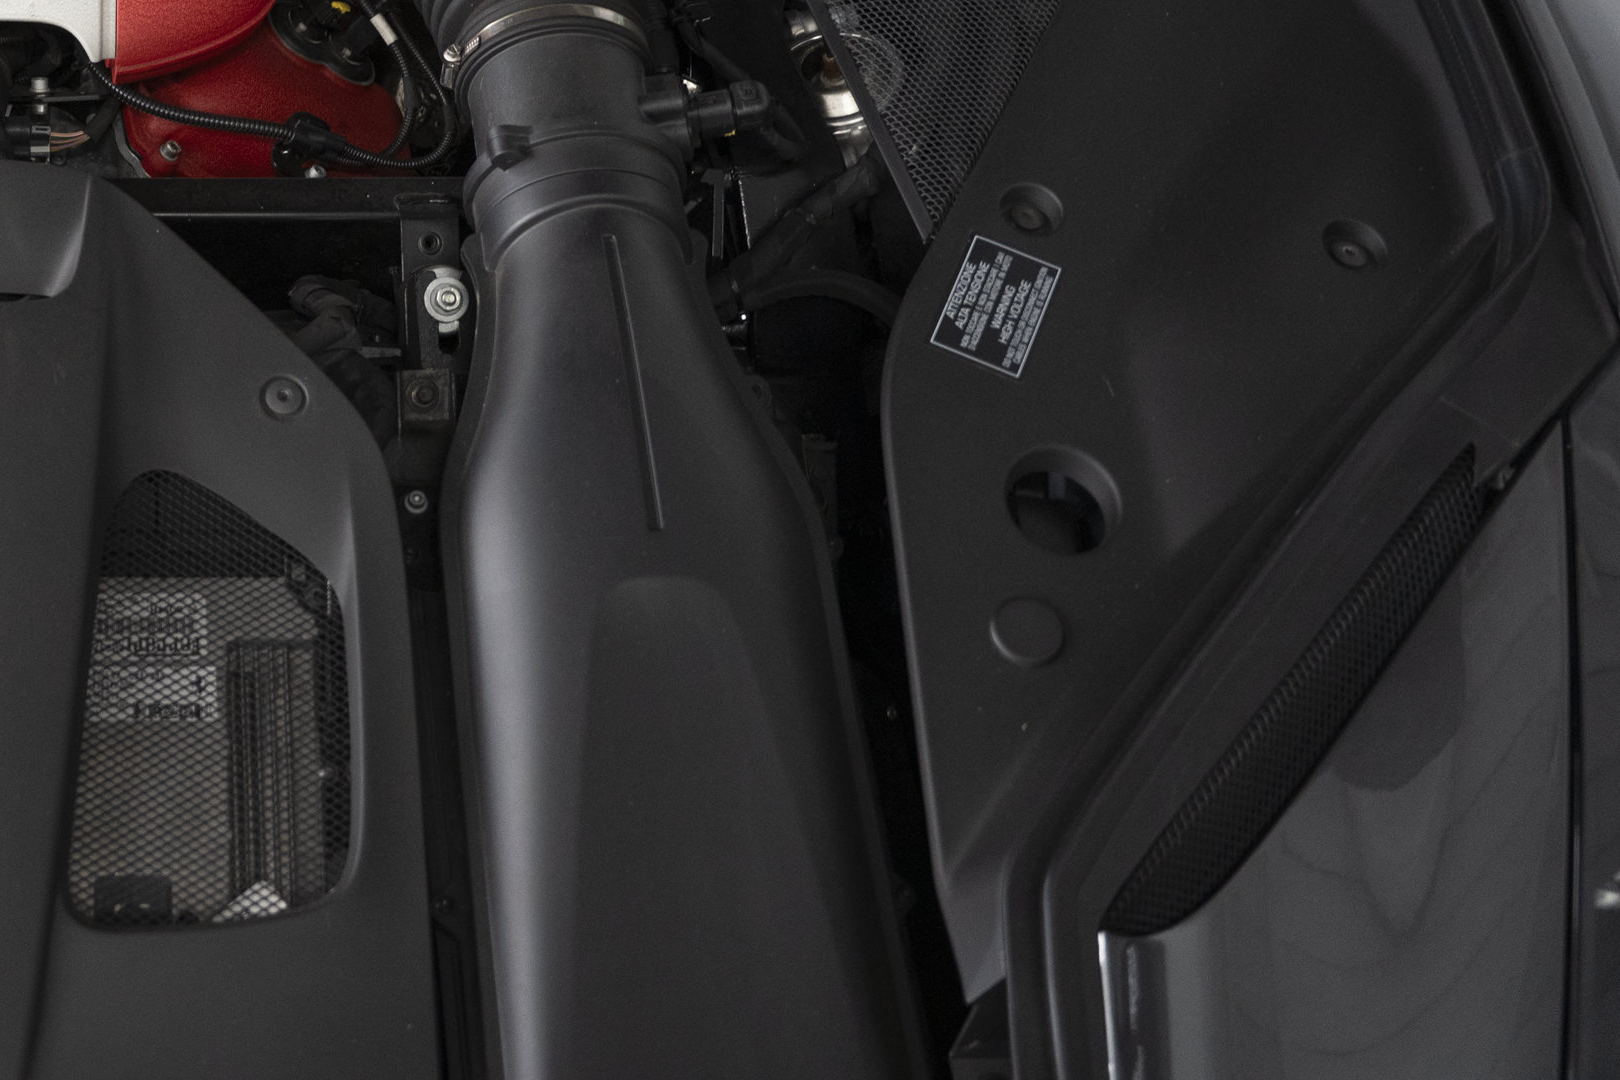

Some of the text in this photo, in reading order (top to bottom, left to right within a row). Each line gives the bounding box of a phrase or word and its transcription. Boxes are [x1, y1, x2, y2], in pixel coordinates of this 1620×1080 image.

[946, 261, 976, 319] ATTENZIONE
[954, 260, 990, 329] ALTA TENSIONE
[990, 283, 1016, 329] WARNING
[997, 278, 1031, 344] HIGH VOLTAGE
